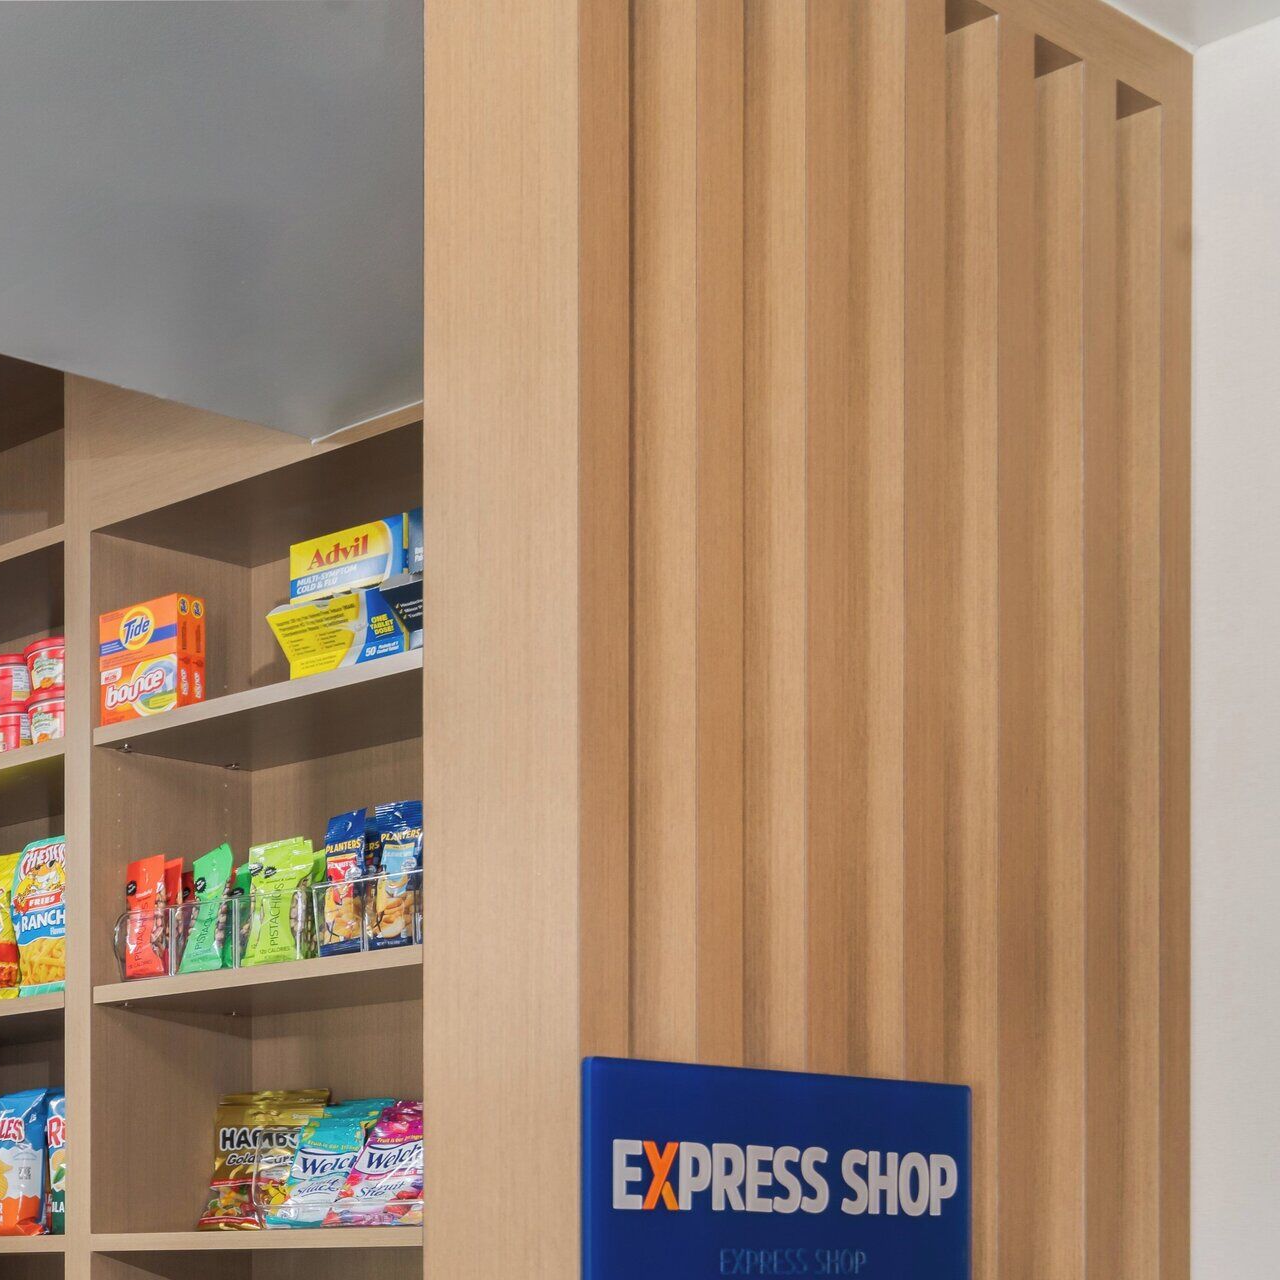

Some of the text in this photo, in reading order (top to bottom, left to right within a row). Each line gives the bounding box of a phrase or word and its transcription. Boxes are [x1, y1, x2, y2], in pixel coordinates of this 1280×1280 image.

[307, 534, 369, 571] Advil
[297, 564, 358, 586] MULTI-SYMPTOM
[296, 582, 316, 594] COLD
[324, 577, 338, 587] FLU
[370, 619, 393, 630] TABLET
[371, 613, 388, 623] ONE
[124, 616, 150, 644] Tide
[374, 626, 394, 635] DOSE!
[366, 646, 377, 656] 50
[106, 668, 166, 709] bounce
[381, 829, 420, 842] PLANTERS
[326, 840, 361, 854] PLANTERS
[29, 895, 55, 906] FRIES
[21, 909, 65, 932] RANCH
[612, 1138, 959, 1217] EXPRESS SHOP
[720, 1248, 867, 1276] EXPRESS SHOP
